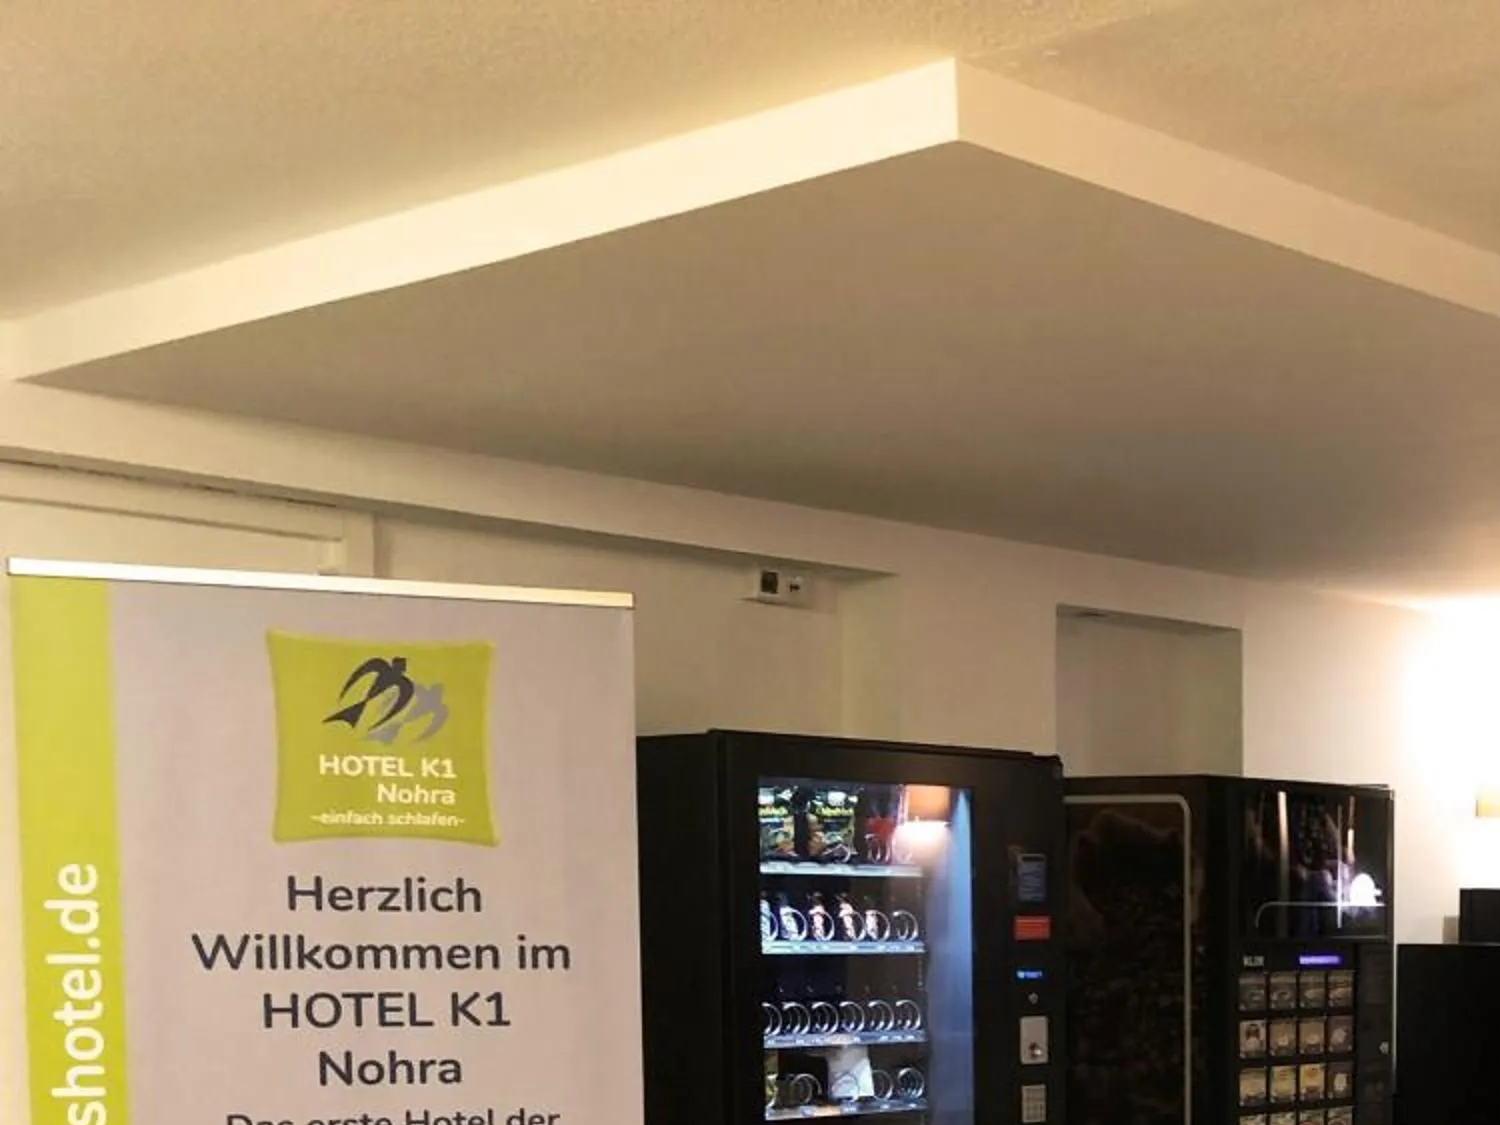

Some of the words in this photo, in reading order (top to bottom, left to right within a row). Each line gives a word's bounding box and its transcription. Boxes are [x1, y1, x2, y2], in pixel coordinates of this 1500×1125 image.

[318, 754, 414, 777] HOTEL
[421, 757, 457, 779] K1
[376, 783, 456, 805] Nohra
[287, 875, 482, 913] Herzlich
[191, 933, 500, 971] Willkommen
[517, 934, 571, 970] im
[263, 991, 435, 1029] HOTEL
[450, 991, 511, 1027] K1
[318, 1050, 463, 1087] Nohra
